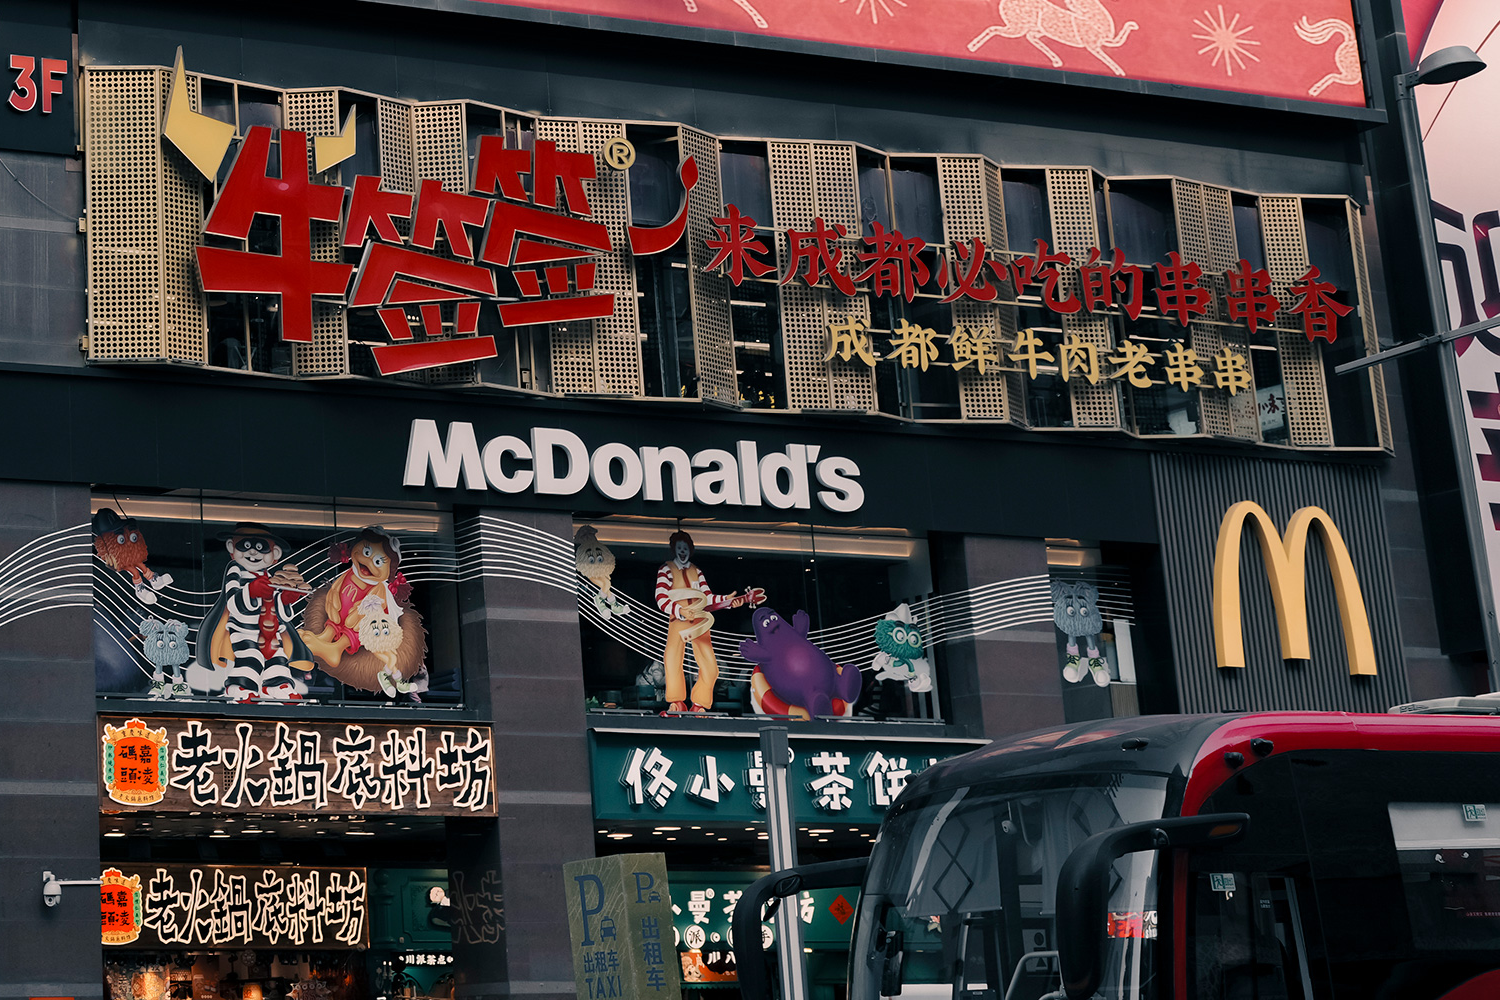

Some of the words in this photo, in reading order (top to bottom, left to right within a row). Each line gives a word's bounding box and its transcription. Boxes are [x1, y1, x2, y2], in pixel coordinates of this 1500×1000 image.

[8, 54, 68, 114] 3F
[190, 112, 615, 376] 牛签签
[704, 203, 1355, 344] 来成都必吃的串串香
[824, 316, 1252, 396] 成都鲜牛肉老串串
[402, 418, 866, 514] McDonald's
[574, 874, 605, 946] P
[632, 872, 655, 904] P
[583, 949, 620, 974] 出租车
[585, 975, 623, 1000] TAXI
[642, 916, 666, 991] 出租车
